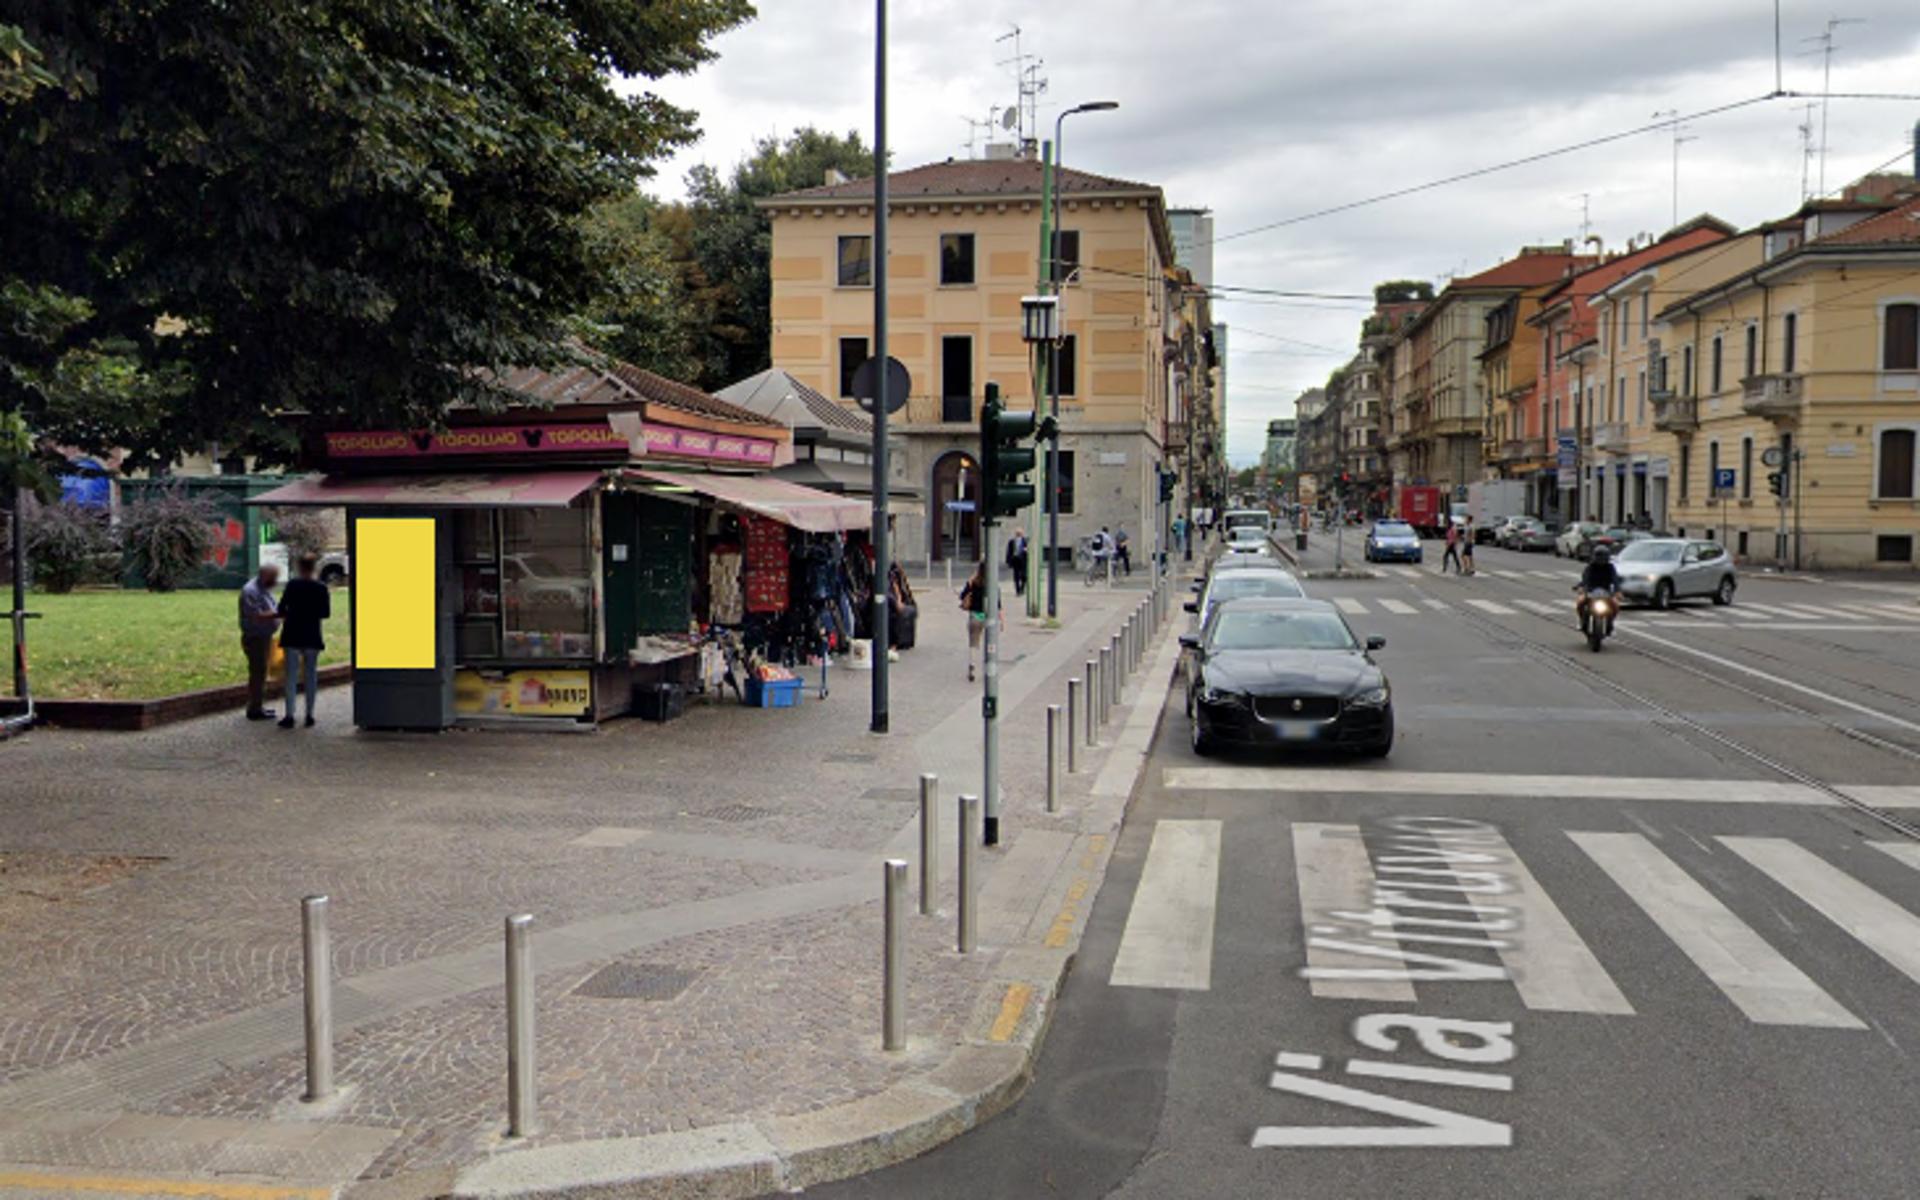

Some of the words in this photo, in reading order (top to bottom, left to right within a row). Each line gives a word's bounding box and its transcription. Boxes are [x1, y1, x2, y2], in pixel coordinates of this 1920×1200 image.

[328, 436, 407, 450] TOPOLINO
[436, 431, 518, 447] TOPOLINO
[1720, 472, 1732, 485] P
